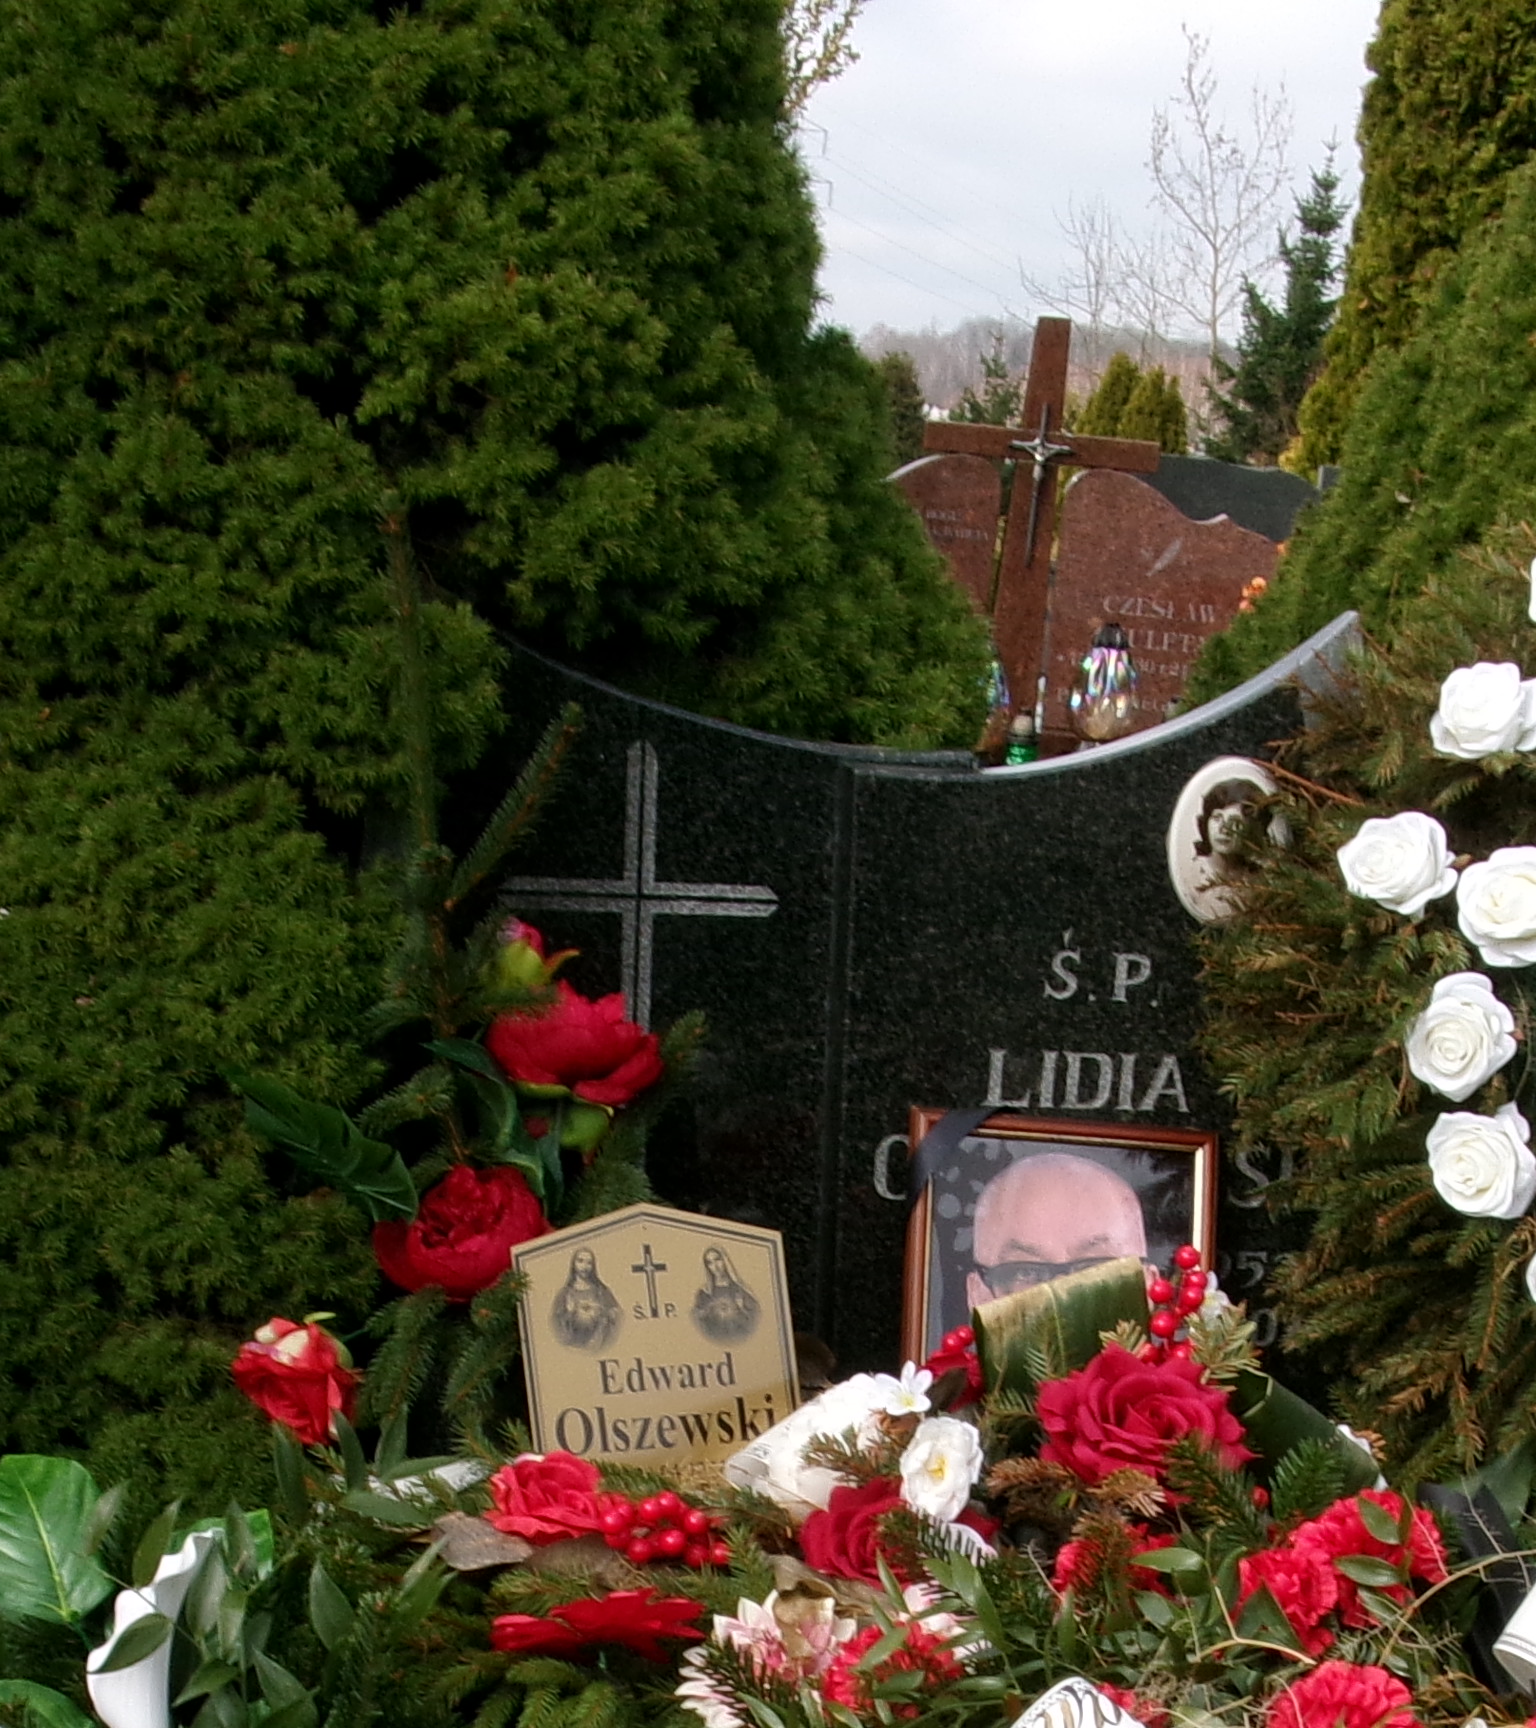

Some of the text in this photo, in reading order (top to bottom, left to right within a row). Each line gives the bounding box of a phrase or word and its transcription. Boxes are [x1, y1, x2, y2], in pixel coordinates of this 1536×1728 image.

[979, 1047, 1190, 1114] LIDIA
[598, 1351, 737, 1396] Edward
[554, 1393, 777, 1456] Olszewski
